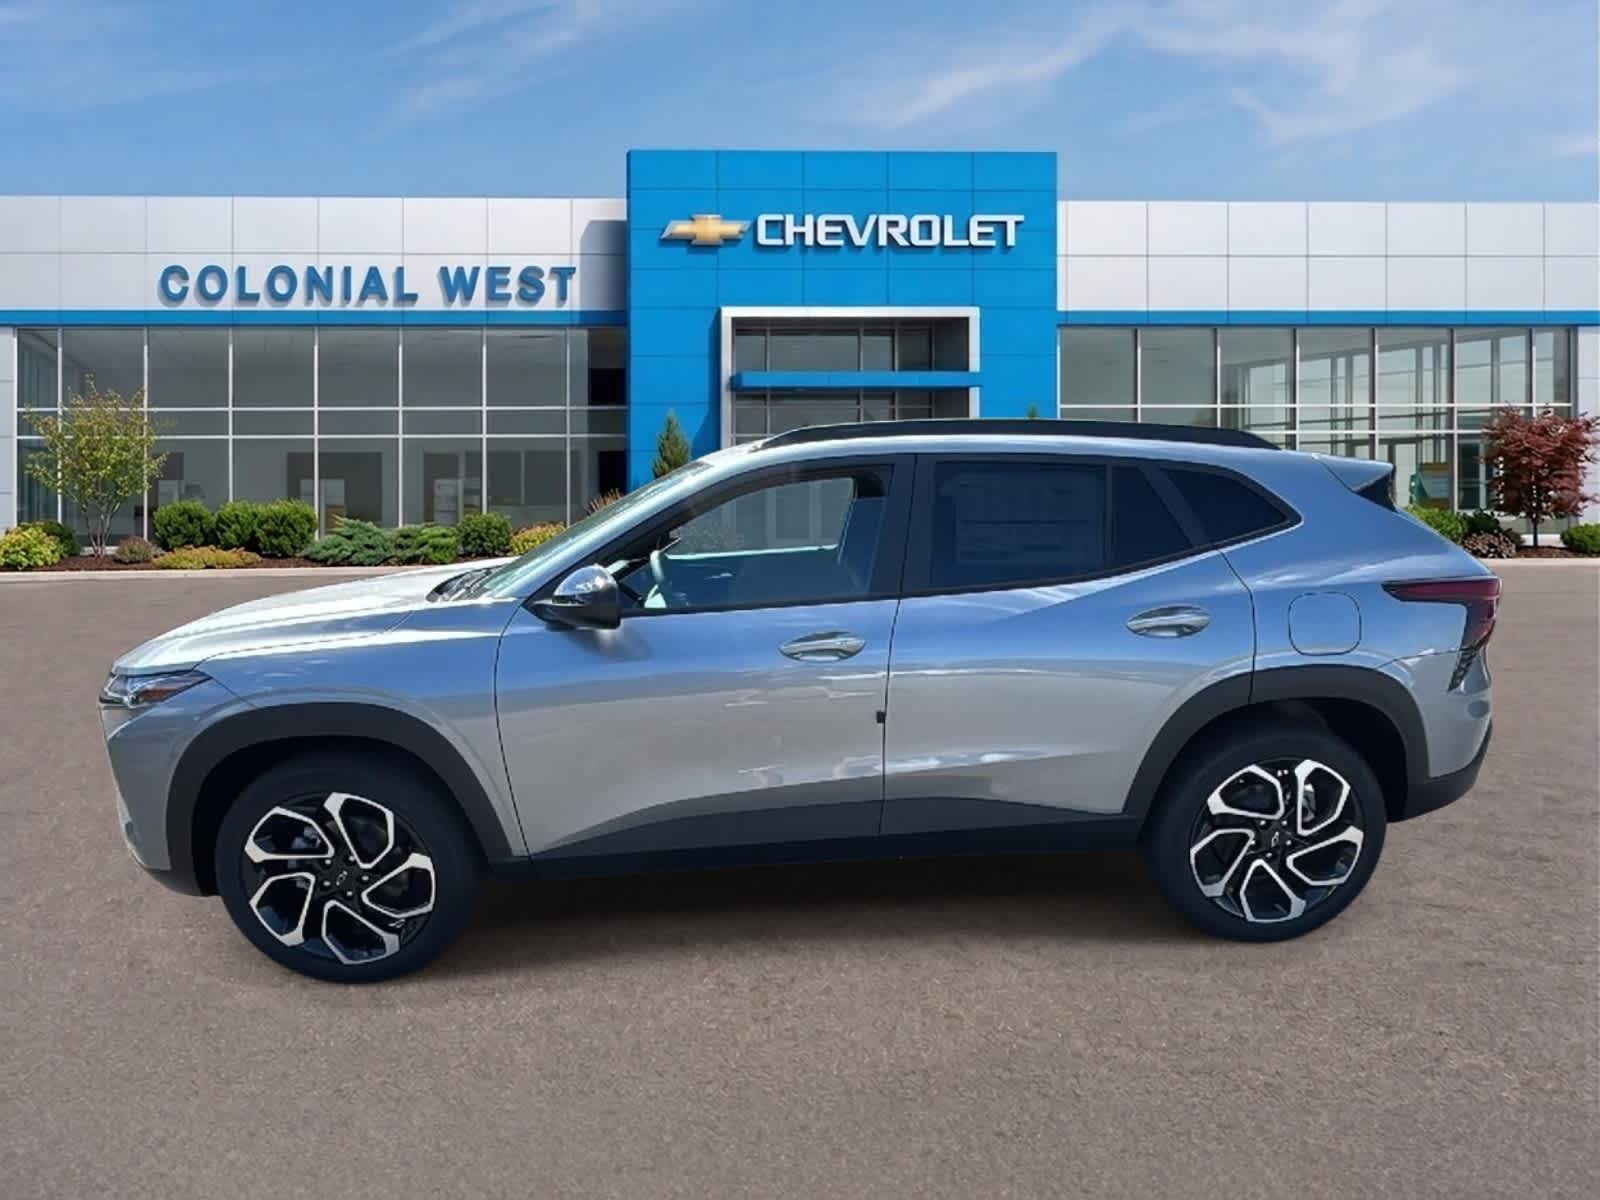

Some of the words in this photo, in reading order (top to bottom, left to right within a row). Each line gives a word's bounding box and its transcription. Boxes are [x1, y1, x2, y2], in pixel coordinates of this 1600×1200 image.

[756, 214, 1024, 247] CHEVROLET
[160, 265, 418, 303] COLONIAL
[438, 265, 577, 303] WEST
